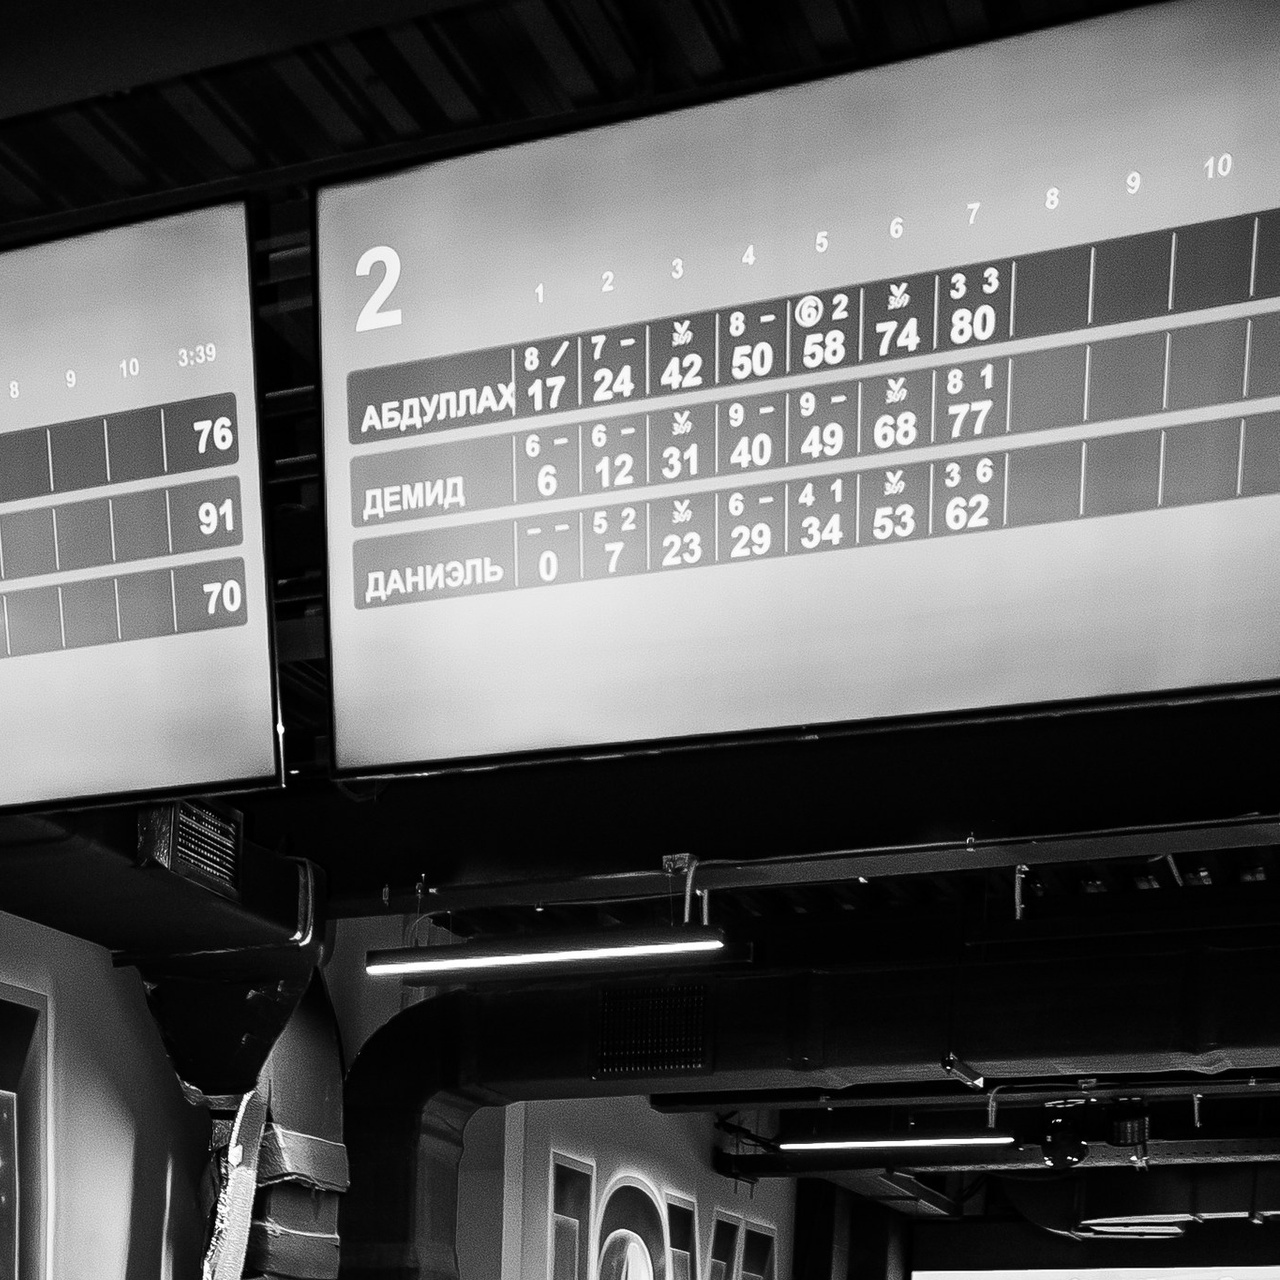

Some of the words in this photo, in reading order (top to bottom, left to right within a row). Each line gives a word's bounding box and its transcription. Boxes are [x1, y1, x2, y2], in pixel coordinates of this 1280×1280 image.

[535, 283, 543, 303] 1
[602, 271, 614, 292] 2
[672, 258, 683, 279] 3
[742, 245, 756, 265] 4
[816, 231, 828, 253] 5
[890, 217, 903, 238] 6
[967, 202, 981, 224] 7
[1046, 187, 1059, 210] 8
[1126, 172, 1141, 194] 9
[1204, 153, 1232, 179] 10
[355, 245, 403, 333] 2
[524, 347, 539, 371] 8
[591, 335, 606, 360] 7
[729, 312, 745, 337] 8
[832, 294, 848, 320] 2
[950, 273, 967, 299] 3
[982, 268, 999, 294] 3
[10, 381, 19, 398] 8
[66, 370, 76, 387] 9
[120, 358, 139, 377] 10
[179, 343, 216, 366] 3:39
[528, 375, 566, 410] 17
[594, 365, 634, 401] 24
[661, 353, 702, 388] 42
[732, 342, 773, 379] 50
[803, 330, 845, 367] 58
[876, 317, 920, 355] 74
[951, 305, 995, 343] 80
[193, 417, 232, 453] 76
[526, 435, 540, 457] 6
[592, 424, 607, 447] 6
[729, 403, 744, 427] 9
[800, 392, 816, 417] 9
[947, 369, 964, 394] 8
[981, 364, 993, 389] 1
[364, 476, 465, 520] ДЕМИД
[538, 465, 557, 496] 6
[595, 453, 633, 487] 12
[662, 443, 698, 478] 31
[730, 433, 772, 467] 40
[801, 422, 843, 457] 49
[874, 412, 916, 448] 68
[948, 400, 993, 438] 77
[593, 511, 608, 534] 5
[622, 508, 636, 531] 2
[729, 493, 744, 516] 6
[798, 483, 815, 506] 4
[831, 479, 842, 503] 1
[945, 463, 961, 487] 3
[976, 458, 993, 483] 6
[199, 499, 233, 535] 91
[366, 557, 503, 602] ДАНИЭЛЬ
[539, 551, 557, 580] 0
[605, 542, 624, 572] 7
[663, 532, 702, 565] 23
[731, 523, 771, 557] 29
[801, 513, 843, 548] 34
[874, 504, 915, 539] 53
[946, 494, 989, 529] 62
[203, 580, 240, 614] 70
